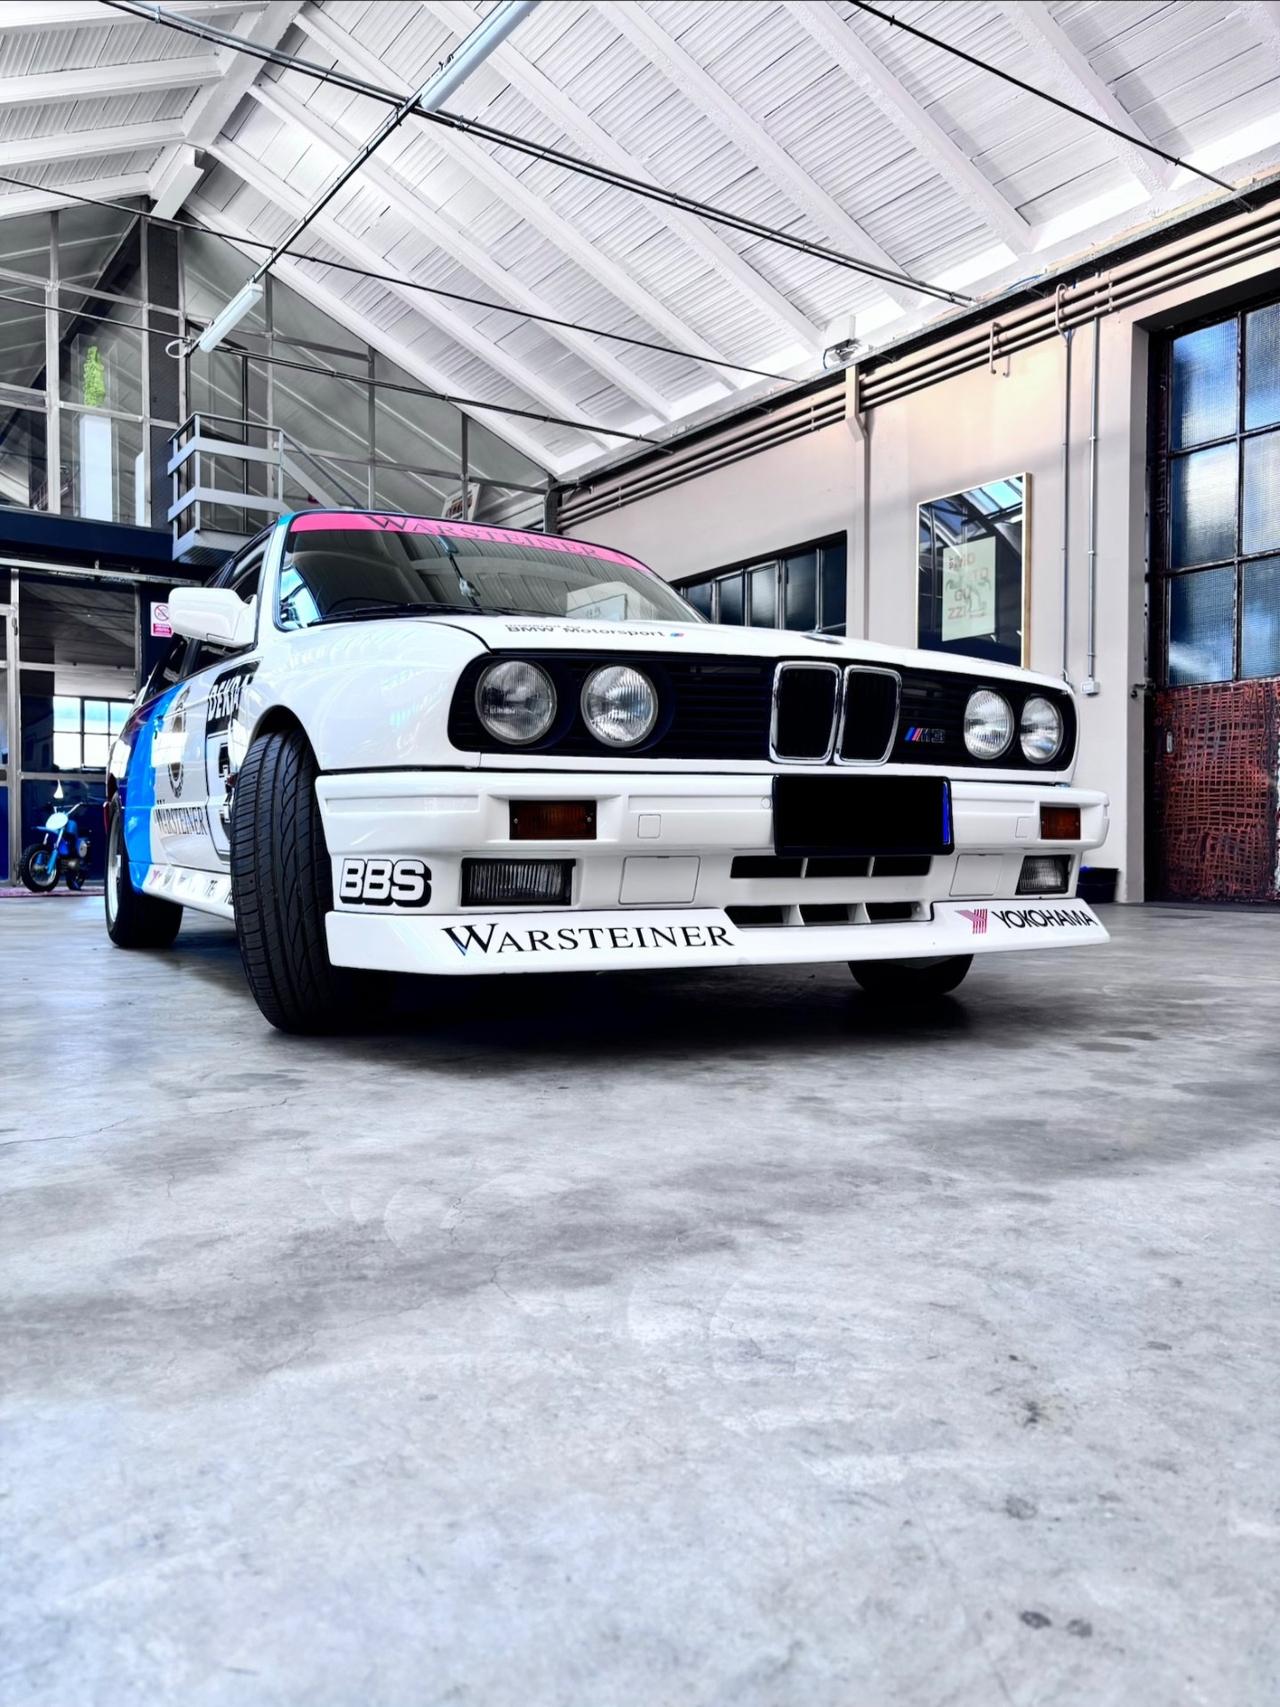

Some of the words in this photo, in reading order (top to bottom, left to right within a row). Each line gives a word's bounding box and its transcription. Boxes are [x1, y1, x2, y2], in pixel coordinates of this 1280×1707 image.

[366, 515, 599, 555] WARSTEINER
[563, 627, 665, 637] Motorsport
[339, 858, 431, 907] BBS
[991, 910, 1098, 929] YOKOHAMA
[441, 922, 735, 957] WARSTEINER
